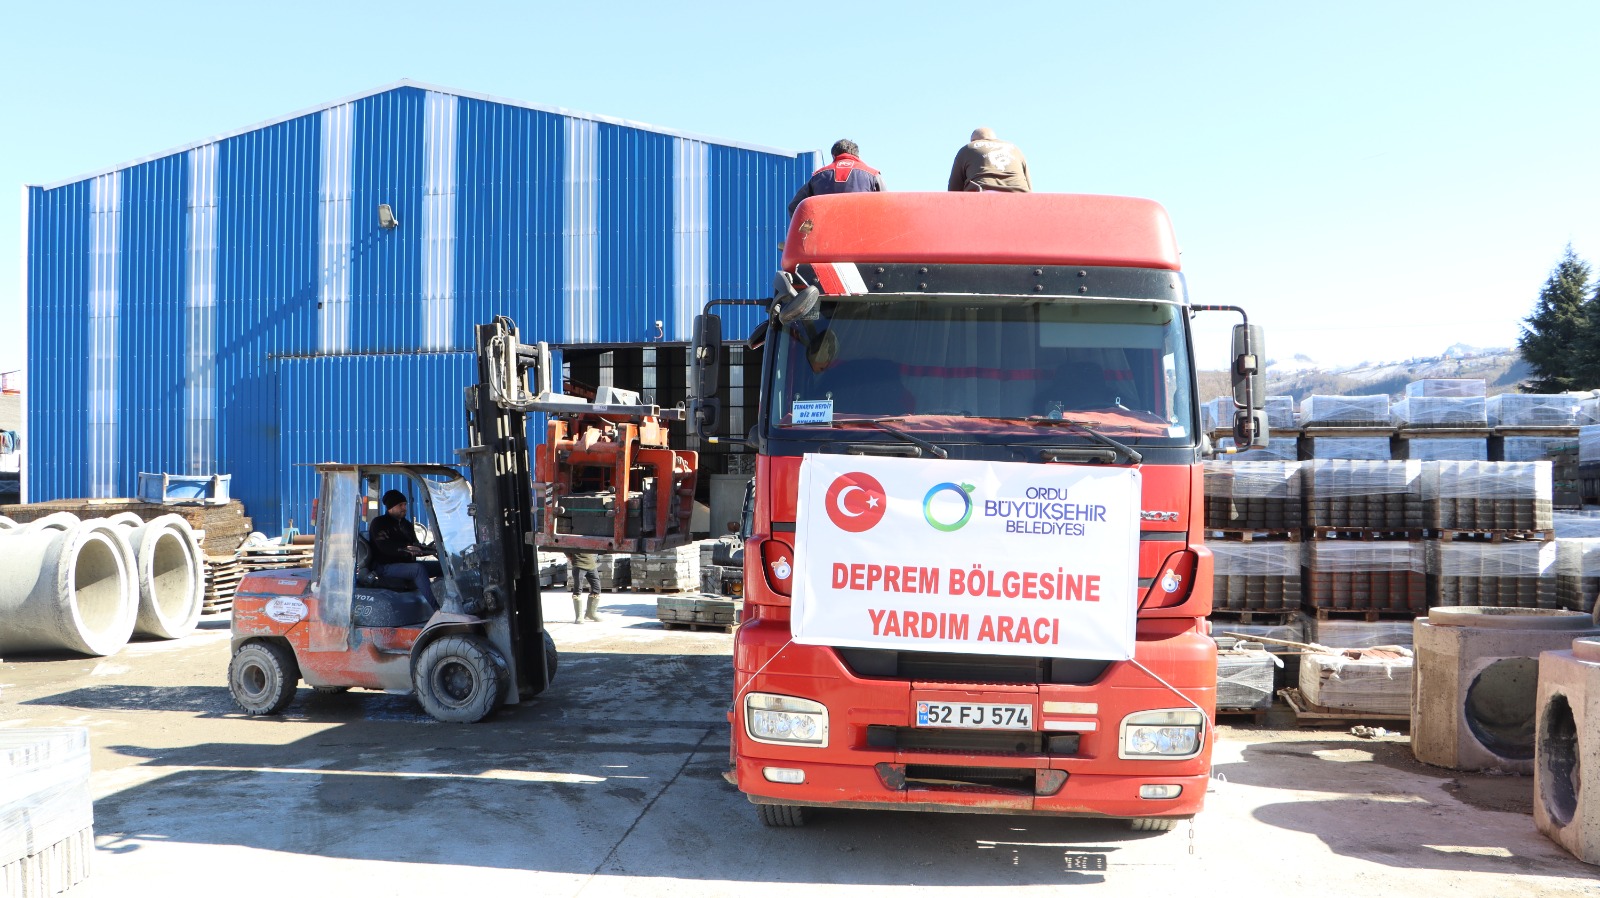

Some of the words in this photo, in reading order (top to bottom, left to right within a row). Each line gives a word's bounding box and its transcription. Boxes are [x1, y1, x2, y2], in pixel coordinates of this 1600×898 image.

[1025, 486, 1068, 501] ORDU
[984, 499, 1107, 522] BÜYÜKŞEHİR
[1140, 510, 1179, 522] XOR
[1005, 519, 1085, 536] BELEDİYESİ
[831, 562, 940, 595] DEPREM
[948, 563, 1101, 602] BÖLGESİNE
[867, 608, 970, 641] YARDIM
[976, 614, 1060, 645] ARACI
[928, 705, 952, 723] 52
[959, 706, 985, 725] FJ
[991, 707, 1028, 726] 574
